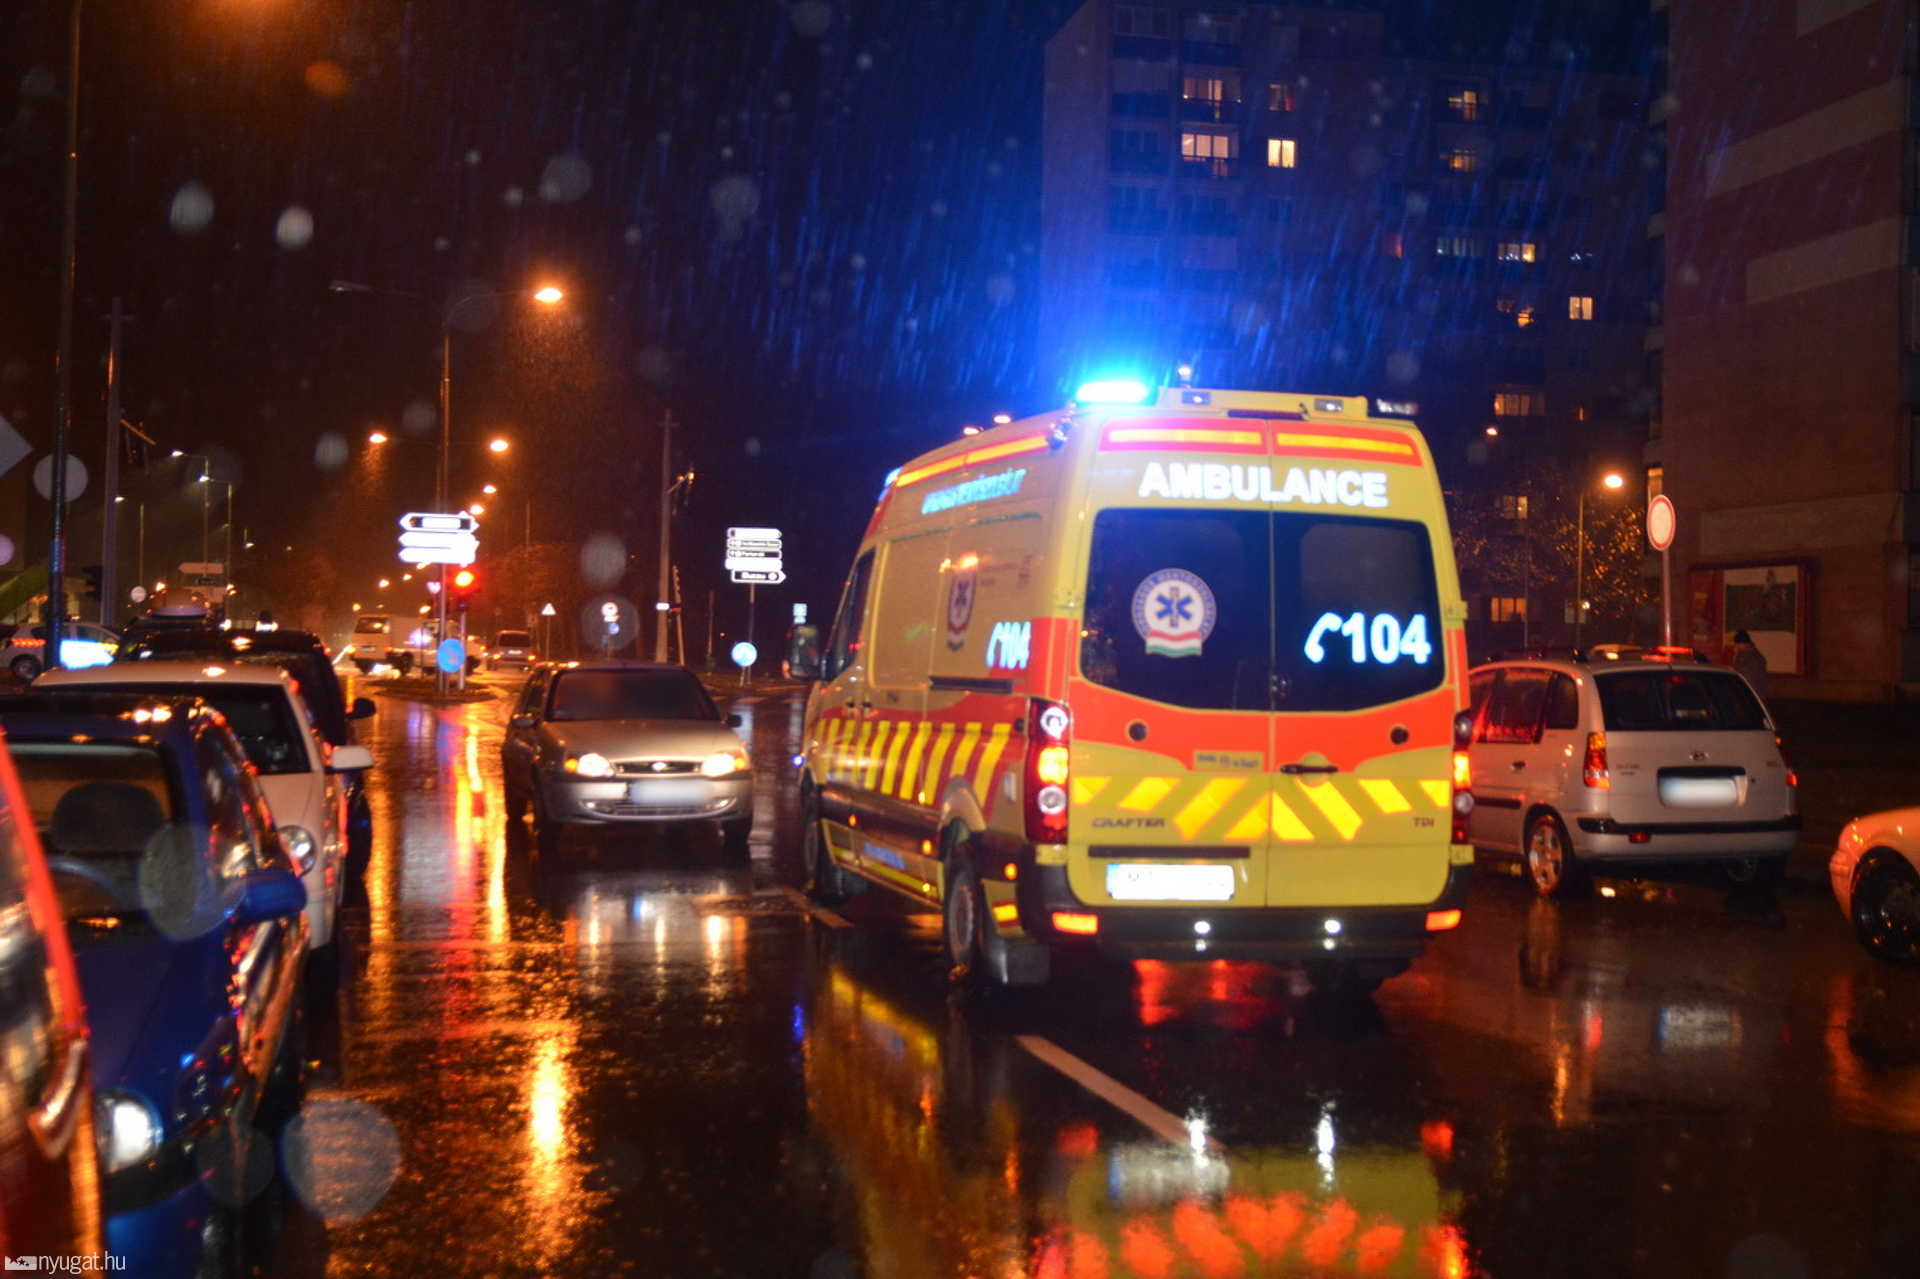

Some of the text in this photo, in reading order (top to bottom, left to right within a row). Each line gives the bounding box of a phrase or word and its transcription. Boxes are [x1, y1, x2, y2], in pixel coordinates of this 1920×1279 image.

[1138, 462, 1388, 507] AMBULANCE
[1341, 613, 1432, 664] 104
[1091, 817, 1166, 828] CRAFTER
